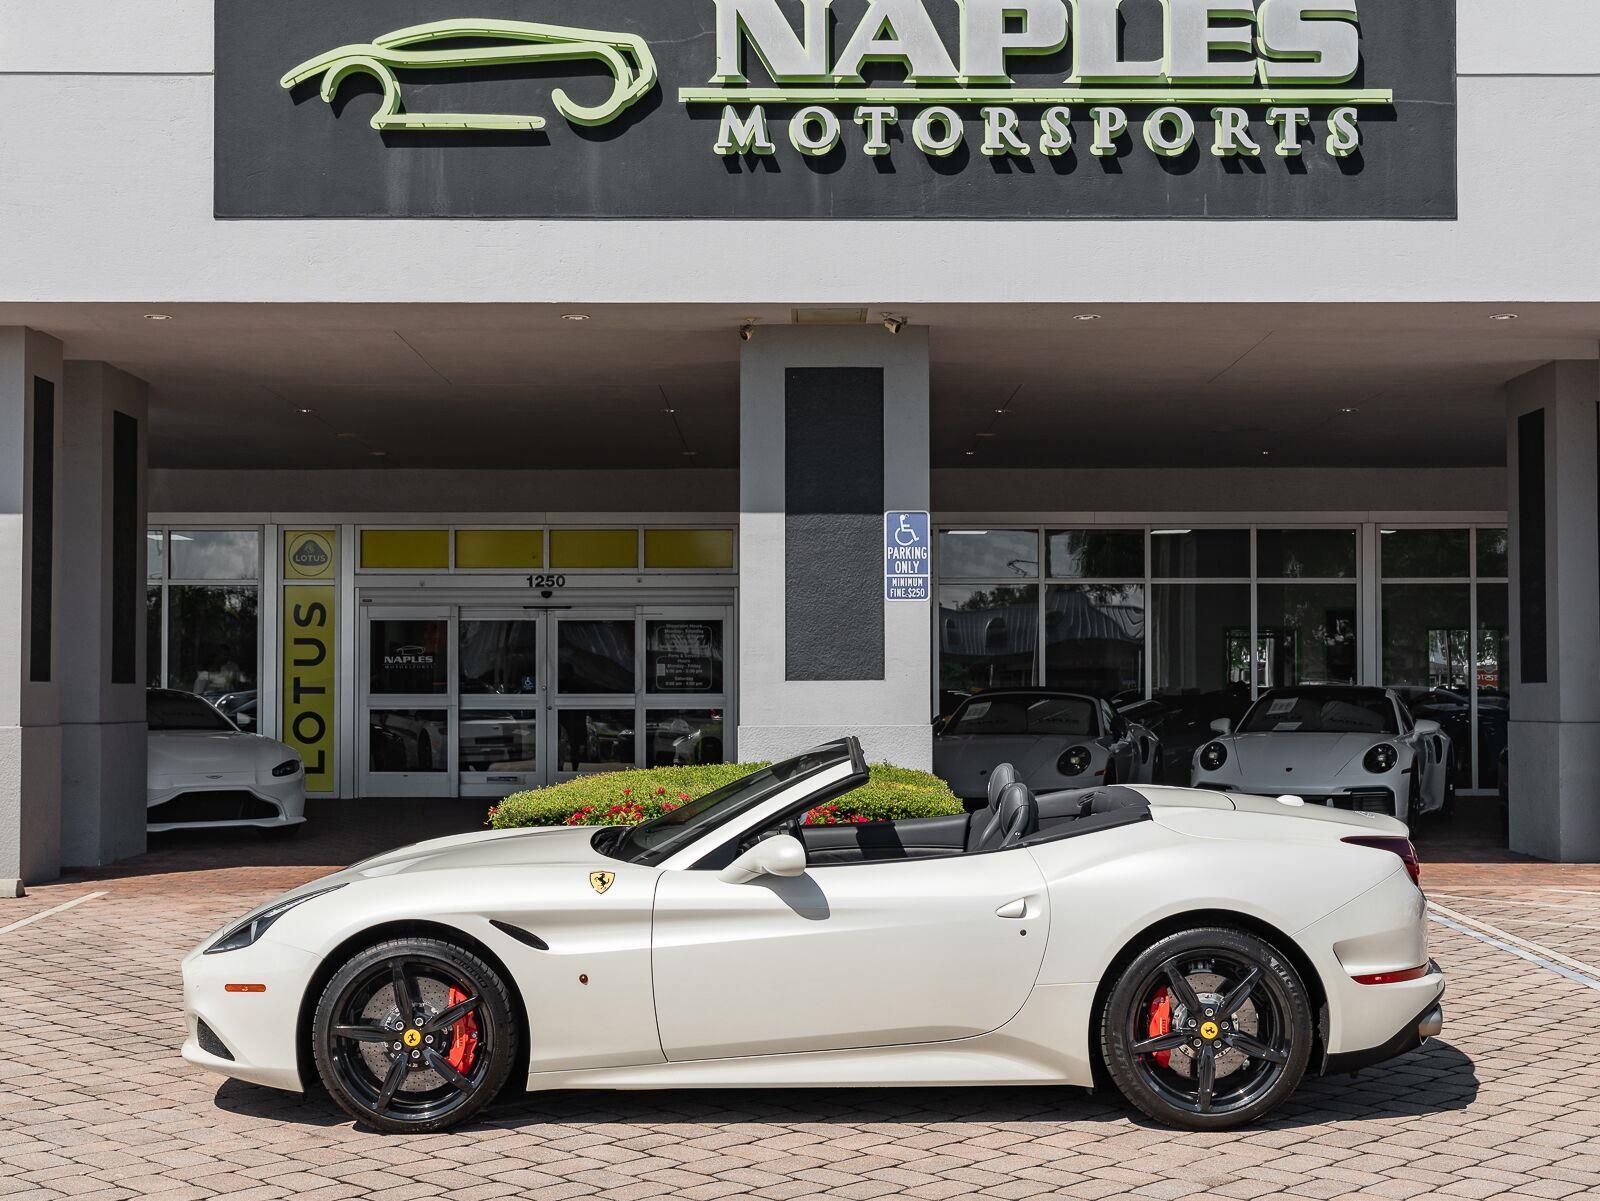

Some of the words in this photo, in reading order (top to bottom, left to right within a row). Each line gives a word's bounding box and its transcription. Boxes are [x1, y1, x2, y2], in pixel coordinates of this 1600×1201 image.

[708, 0, 1358, 84] NAPLES
[713, 105, 1360, 156] MOTORSPORTS
[887, 546, 927, 560] PARKING
[895, 560, 920, 574] ONLY
[526, 574, 566, 587] 1250
[892, 577, 923, 587] MINIMUM
[384, 655, 433, 664] NAPLES
[293, 602, 326, 774] LOTUS
